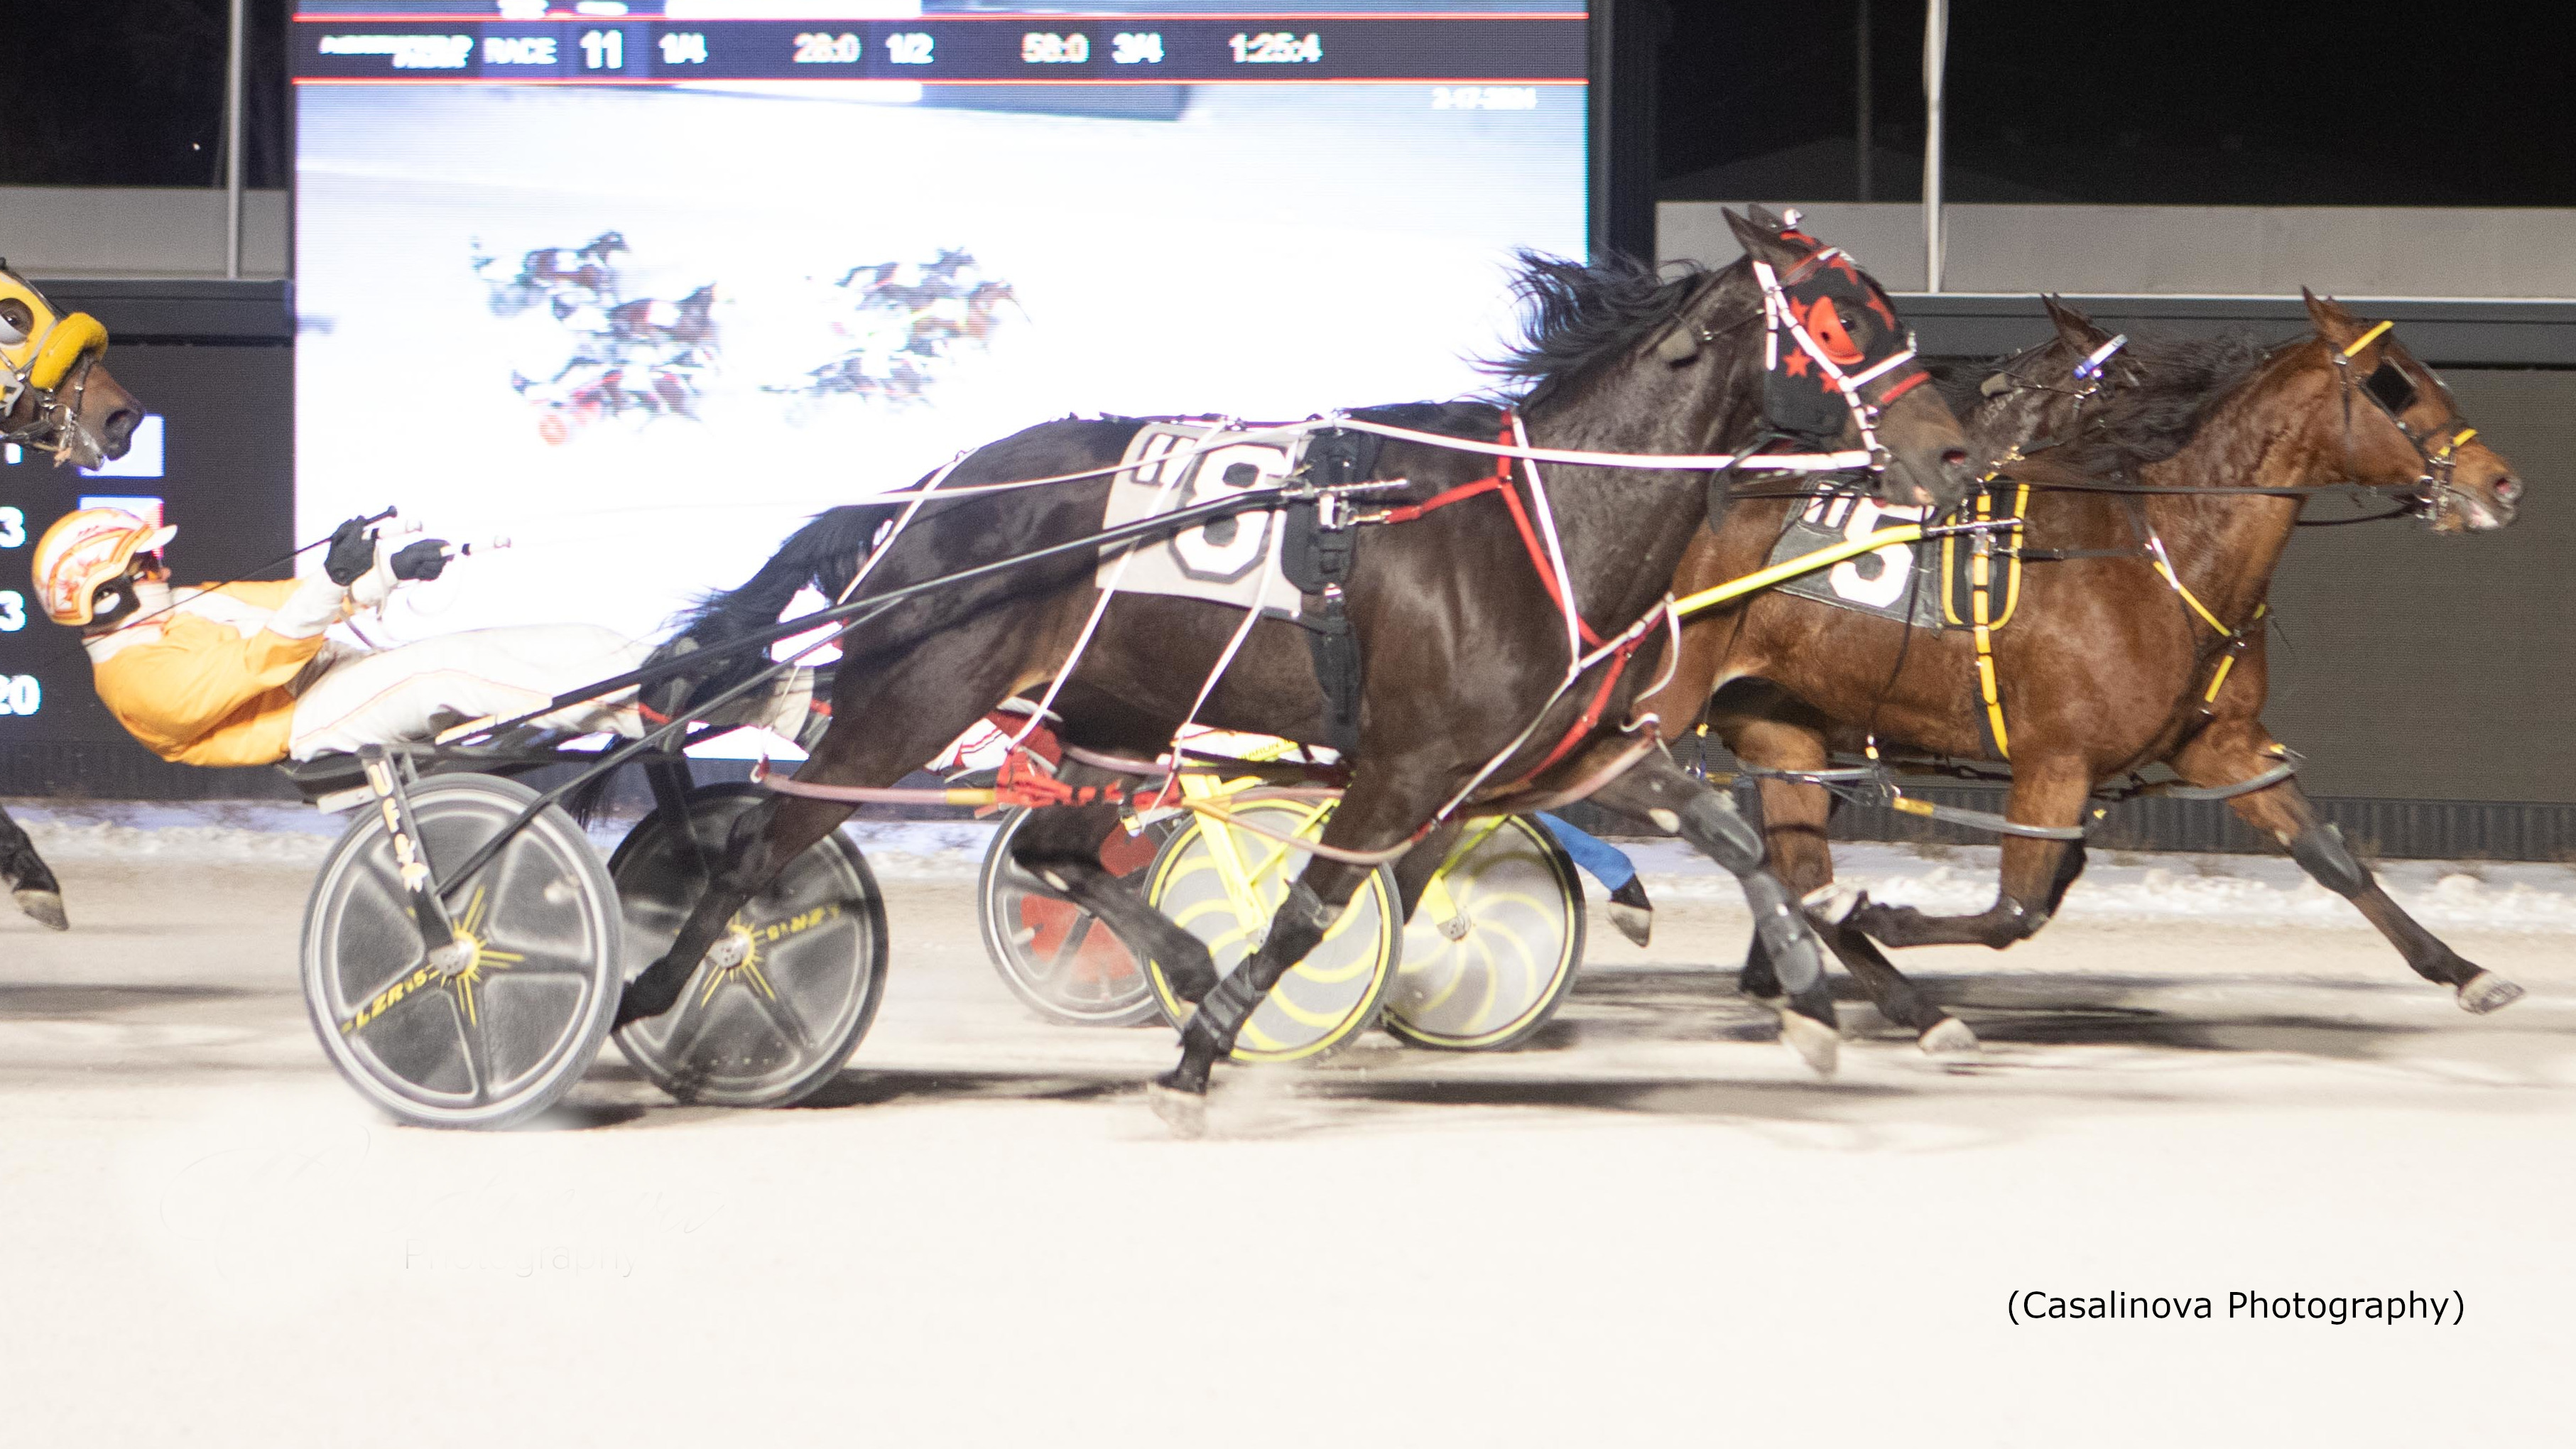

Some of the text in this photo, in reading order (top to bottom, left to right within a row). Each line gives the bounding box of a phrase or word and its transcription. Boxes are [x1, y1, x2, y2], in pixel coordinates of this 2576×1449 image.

[484, 36, 558, 64] RACE
[580, 29, 623, 69] 11
[659, 32, 708, 64] 1/4
[886, 32, 935, 64] 1/2
[1112, 32, 1165, 64] 3/4
[1172, 442, 1294, 582] 8
[1830, 492, 1935, 608] 5
